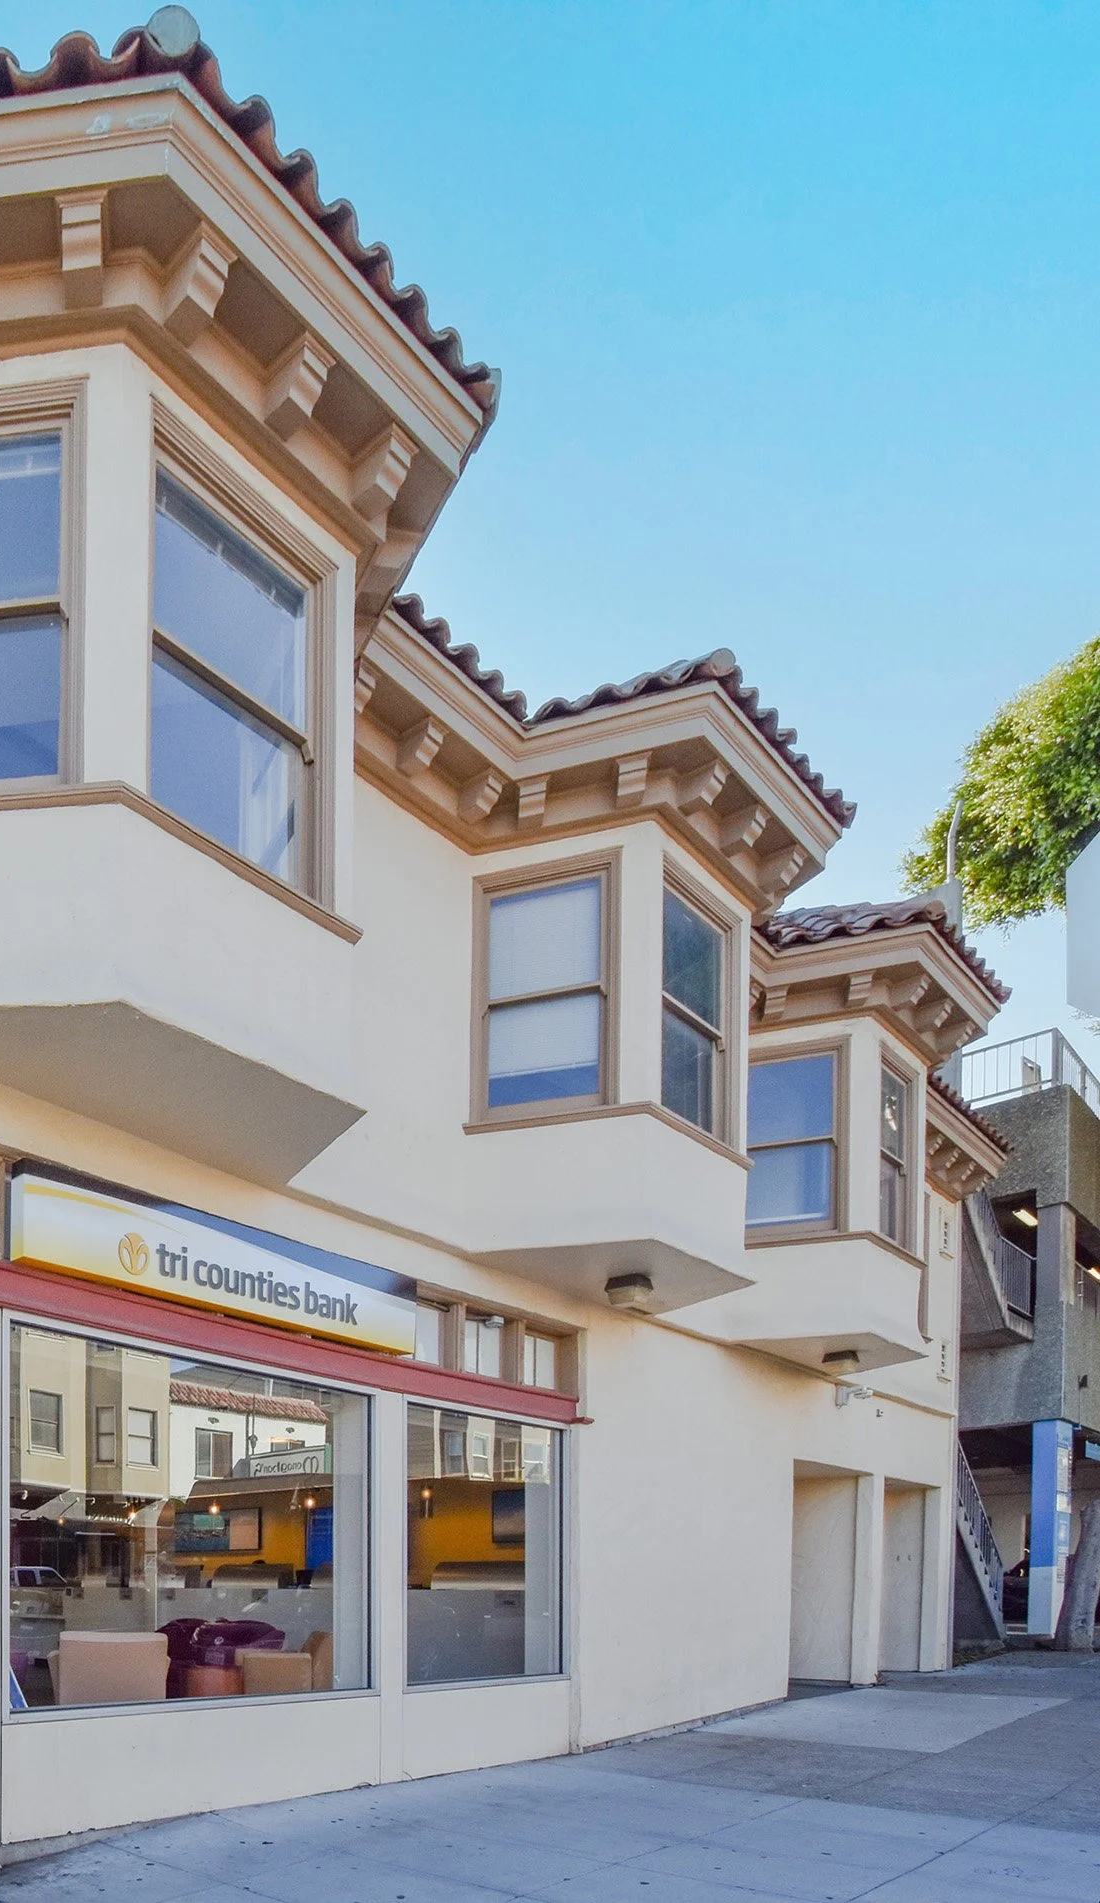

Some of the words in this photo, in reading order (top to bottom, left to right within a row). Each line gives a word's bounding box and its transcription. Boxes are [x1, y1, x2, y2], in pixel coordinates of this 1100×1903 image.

[155, 1243, 188, 1282] tri
[193, 1259, 301, 1311] counties
[304, 1281, 359, 1326] bank
